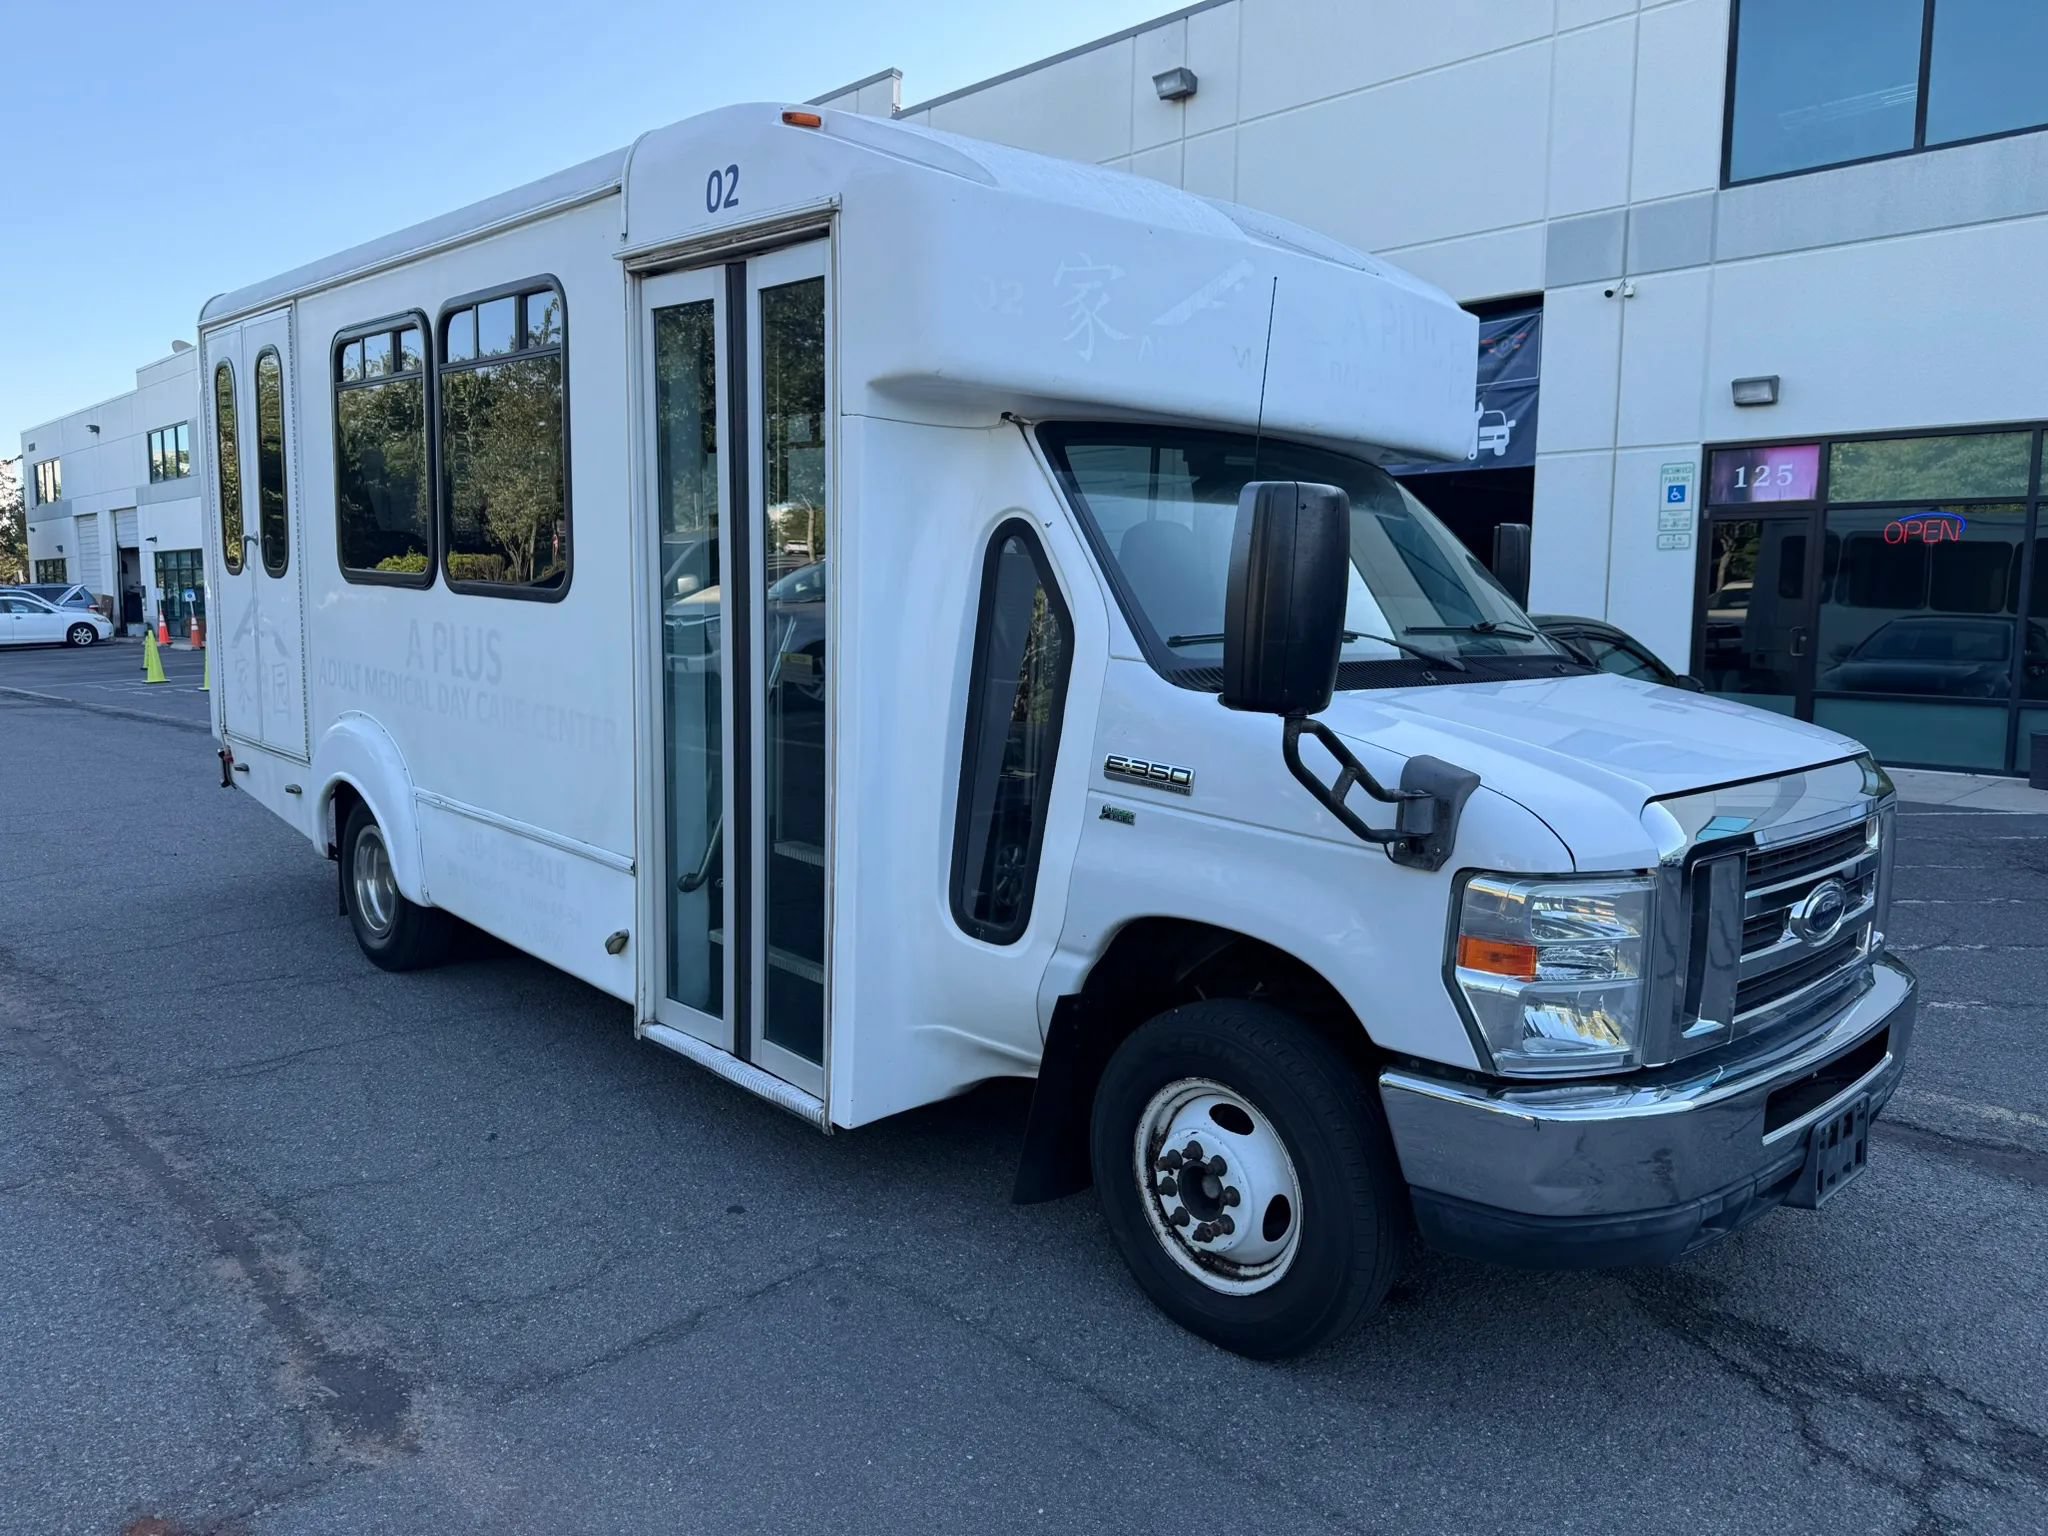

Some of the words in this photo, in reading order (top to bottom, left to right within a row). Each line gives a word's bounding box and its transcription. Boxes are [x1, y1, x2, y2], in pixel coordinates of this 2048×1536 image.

[706, 164, 739, 213] 02
[1053, 251, 1128, 361] 家
[1734, 464, 1793, 488] 125
[1884, 519, 1961, 545] OPEN
[406, 619, 425, 670] A
[432, 621, 503, 686] PLUS
[319, 656, 361, 694] ADULT
[364, 665, 434, 713] MEDICAL
[437, 681, 471, 721] DAY
